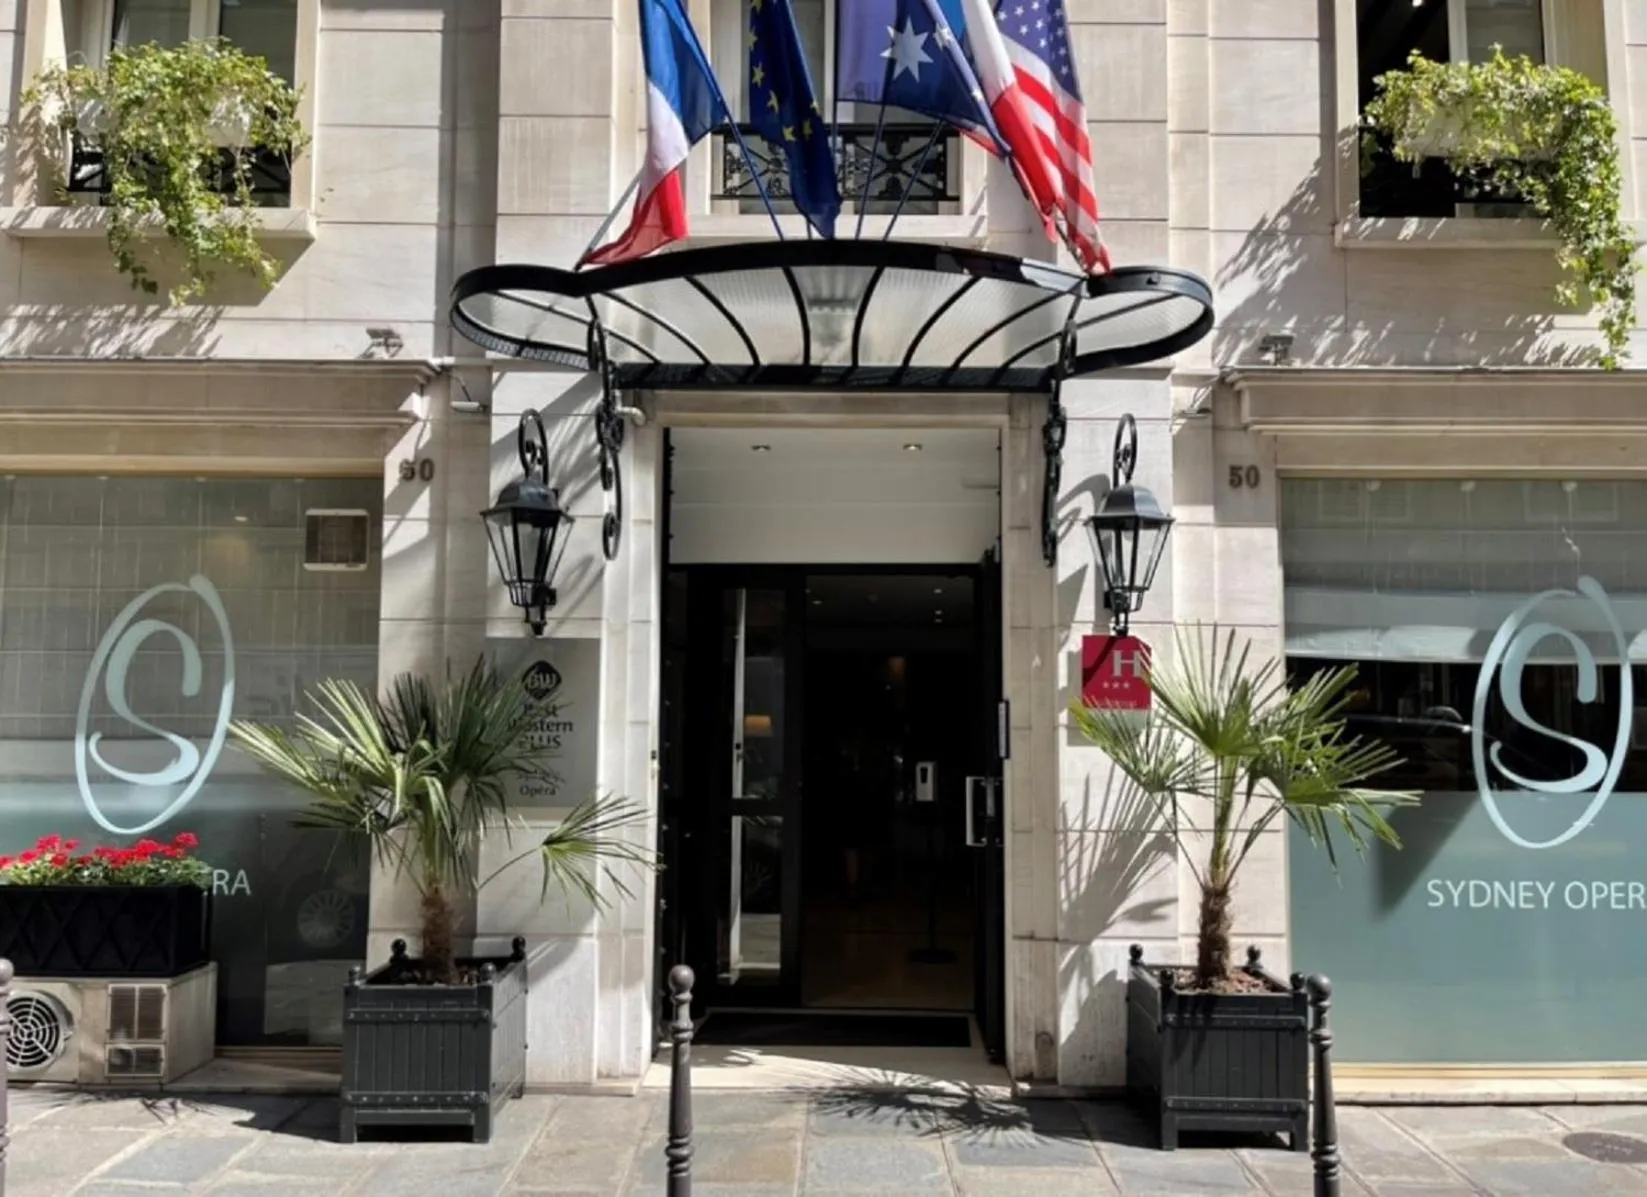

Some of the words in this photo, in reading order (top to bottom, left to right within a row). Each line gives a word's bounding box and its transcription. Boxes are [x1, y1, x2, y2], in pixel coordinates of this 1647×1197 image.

[1229, 464, 1261, 489] 50
[1112, 650, 1143, 677] H
[1426, 879, 1556, 909] SYDNEY
[1564, 880, 1647, 910] OPER
